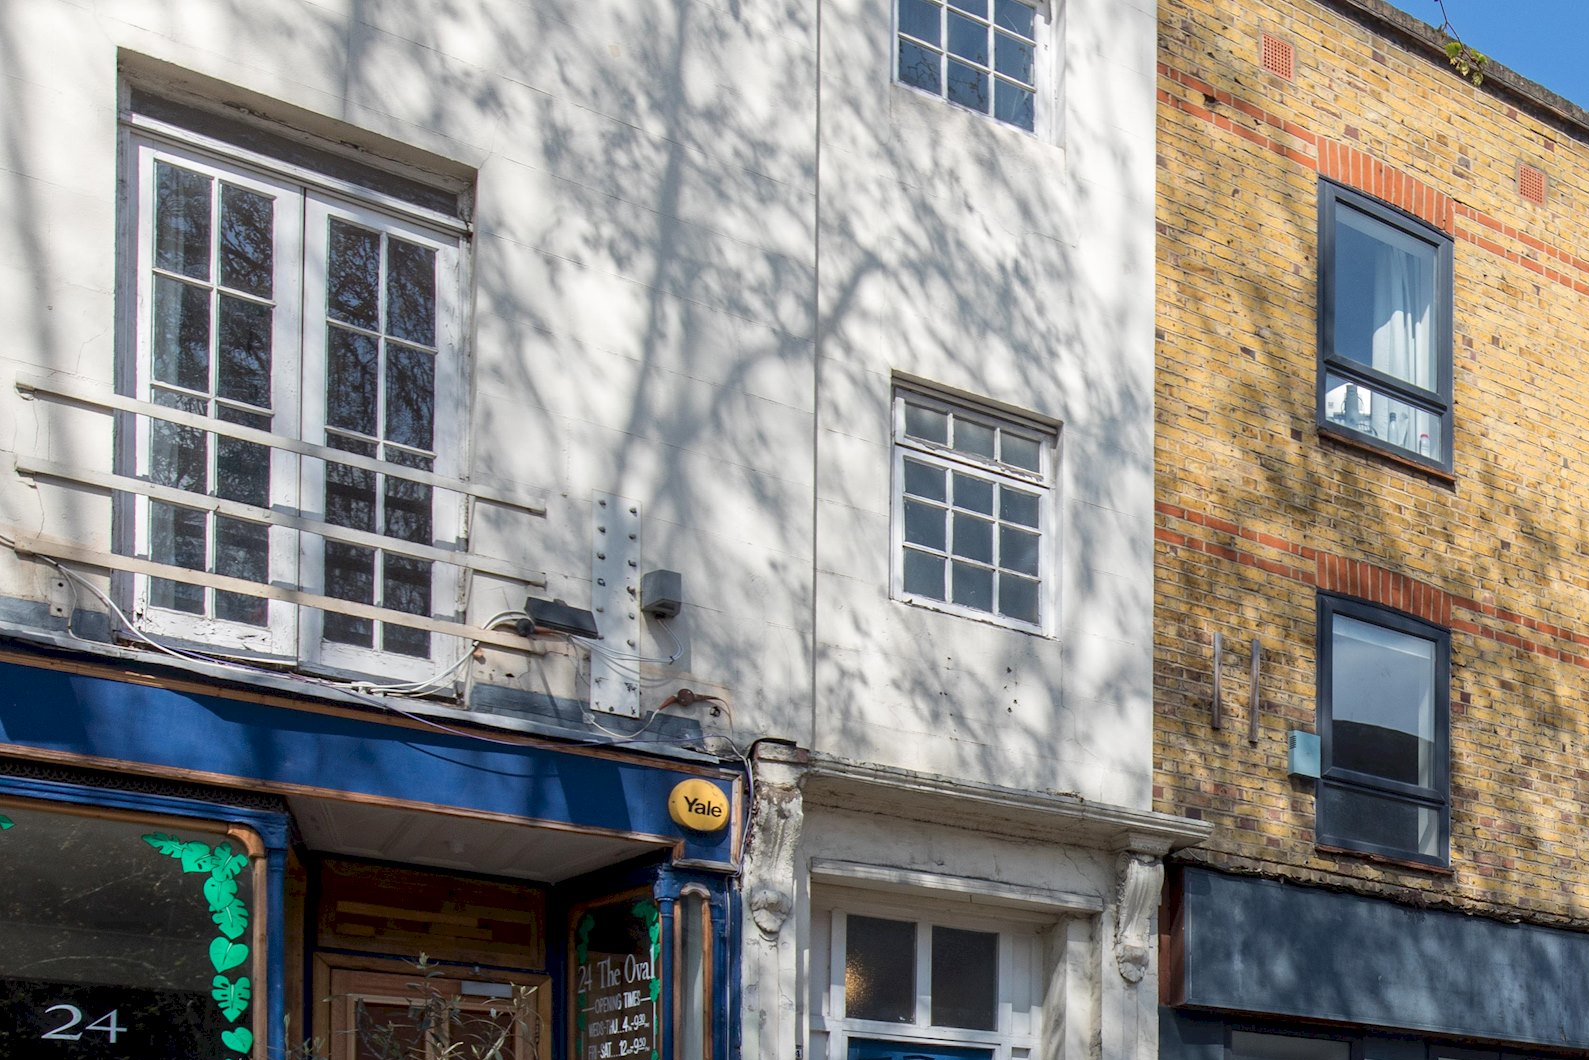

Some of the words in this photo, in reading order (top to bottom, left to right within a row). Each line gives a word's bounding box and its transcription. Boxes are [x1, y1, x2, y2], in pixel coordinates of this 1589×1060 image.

[684, 795, 722, 817] Yale
[577, 964, 592, 994] 24
[597, 956, 621, 989] The
[624, 947, 655, 984] Oval
[594, 993, 622, 1014] OPENING
[623, 990, 641, 1008] TIMES
[41, 1004, 128, 1043] 24
